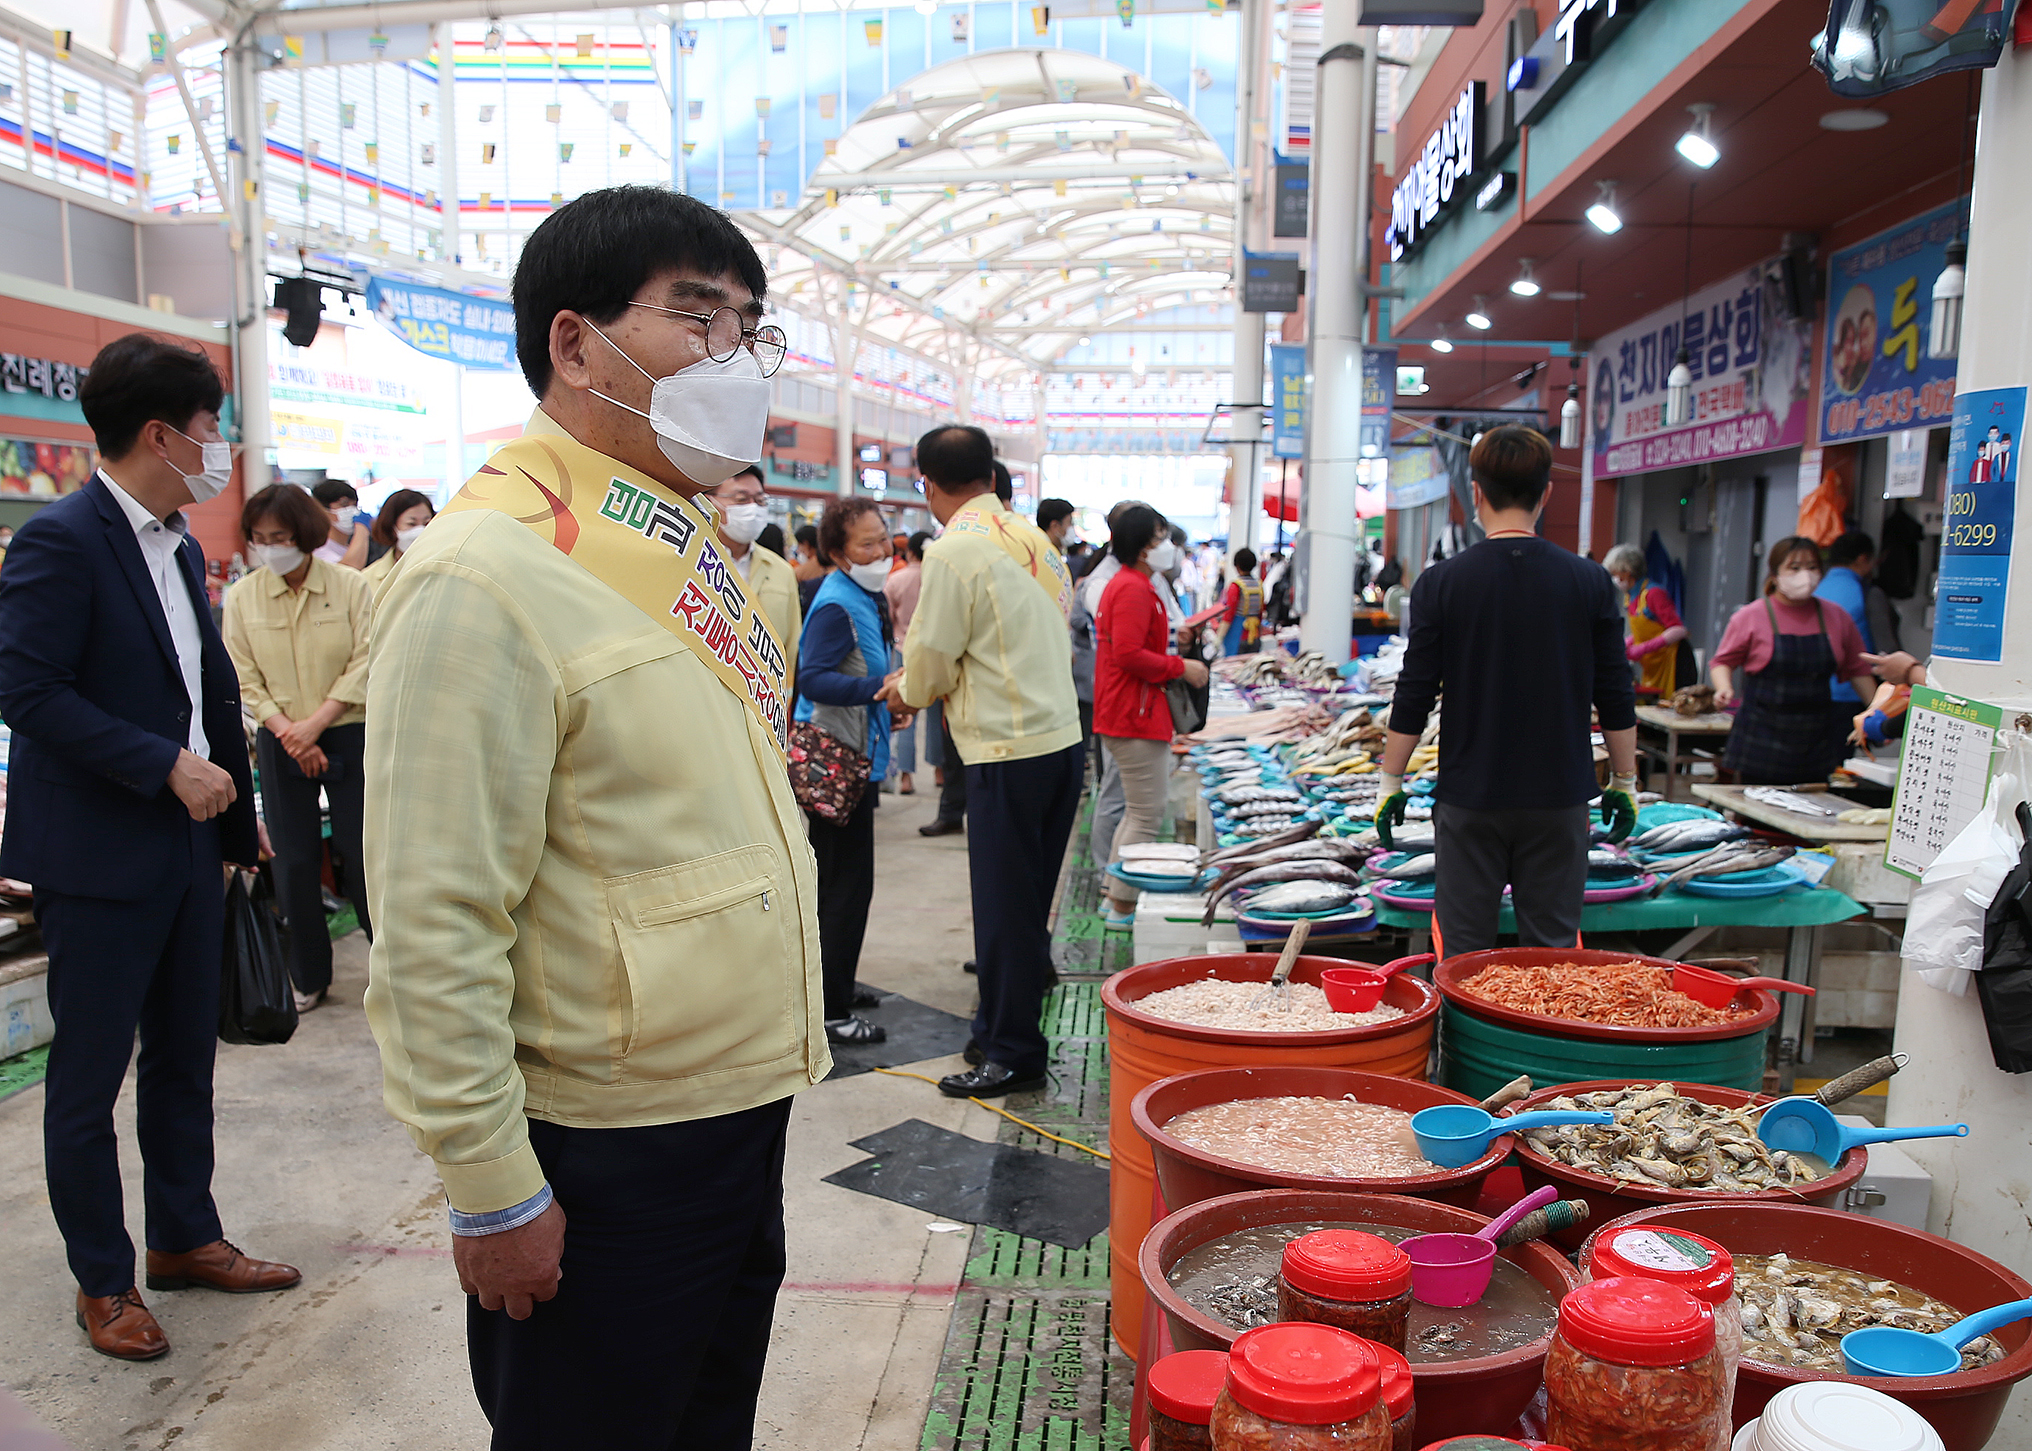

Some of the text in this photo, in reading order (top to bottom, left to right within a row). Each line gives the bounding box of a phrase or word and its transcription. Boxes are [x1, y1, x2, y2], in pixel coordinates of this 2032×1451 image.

[1617, 286, 1761, 403] 천지어물상회
[601, 478, 697, 556] 덤과
[697, 540, 746, 622] 정이
[1931, 698, 1978, 721] 원산지표시판
[1946, 720, 1965, 732] 원산지
[1975, 730, 1988, 739] 가격
[1049, 1298, 1087, 1412] 함평천지전통시장
